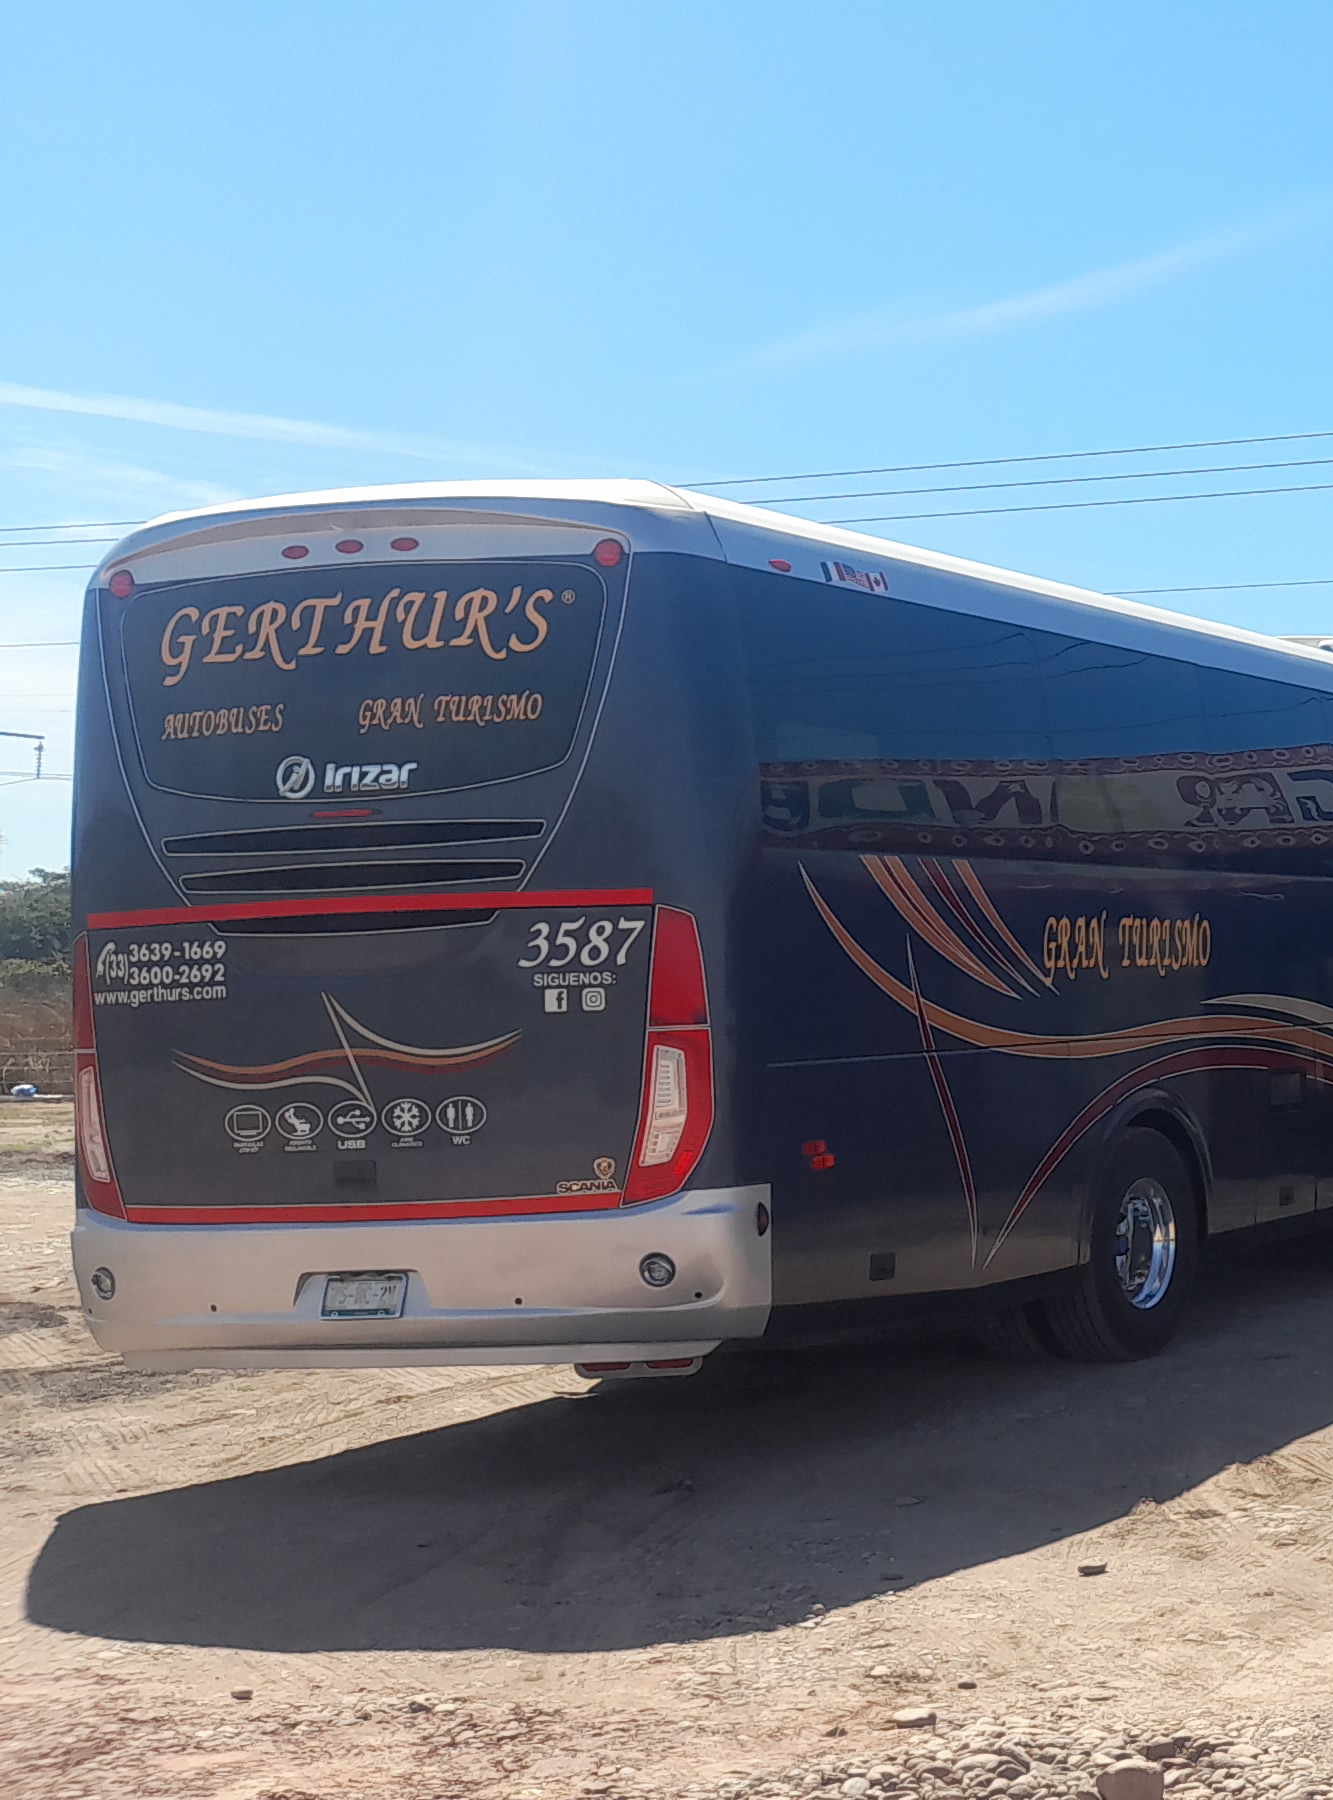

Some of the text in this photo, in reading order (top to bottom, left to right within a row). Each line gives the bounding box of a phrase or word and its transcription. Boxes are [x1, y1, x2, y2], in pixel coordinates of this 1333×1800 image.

[161, 690, 544, 740] AUTOBUSES GRAN TURISMO
[517, 915, 646, 968] 3587
[1043, 909, 1212, 986] GRAN TURISMO
[106, 940, 226, 985] (33) 3639-1669
[129, 963, 225, 985] 3600-2692
[533, 972, 617, 986] SIGUENOS:
[94, 985, 227, 1008] www.gerthurs.com
[337, 1135, 471, 1150] USB WC
[558, 1181, 616, 1193] SCANIA
